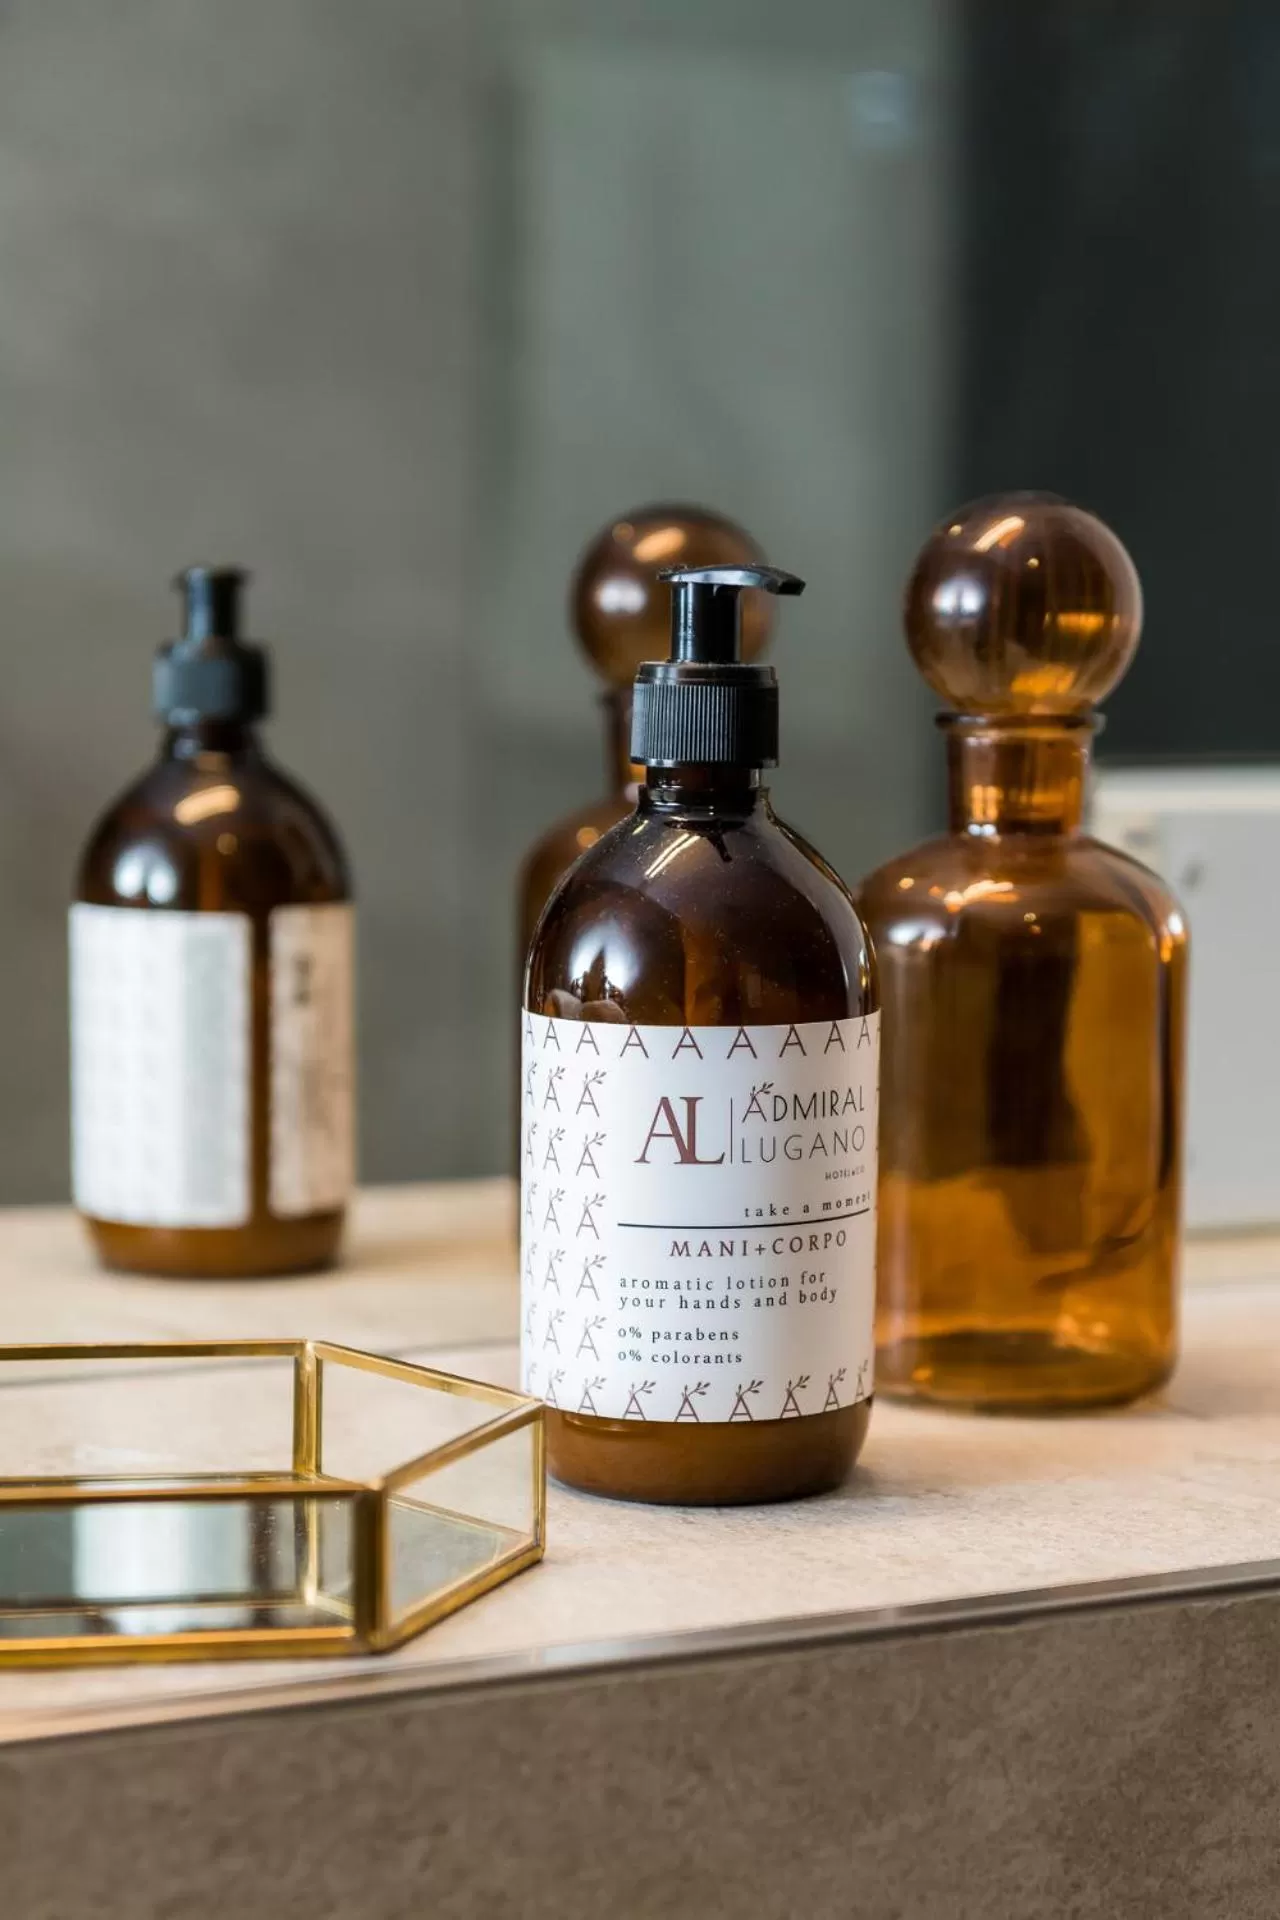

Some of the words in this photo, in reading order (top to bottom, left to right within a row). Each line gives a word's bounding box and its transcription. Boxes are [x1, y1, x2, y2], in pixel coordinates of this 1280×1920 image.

[543, 1018, 561, 1052] A
[576, 1022, 600, 1056] A
[620, 1025, 649, 1059] A
[672, 1026, 703, 1060] A
[726, 1025, 757, 1060] A
[778, 1023, 807, 1058] A
[824, 1020, 845, 1054] A
[633, 1096, 725, 1165] AL
[742, 1082, 865, 1123] ADMIRAL
[741, 1125, 865, 1163] LUGANO
[744, 1203, 790, 1218] take
[802, 1203, 810, 1214] a
[669, 1229, 847, 1258] MANI+CORPO
[619, 1276, 714, 1291] aromatic
[726, 1275, 790, 1290] lotion
[800, 1270, 826, 1285] for
[618, 1295, 667, 1310] your
[678, 1295, 742, 1310] hands
[753, 1291, 788, 1308] and
[799, 1286, 837, 1305] body
[617, 1326, 642, 1340] 0%
[651, 1327, 740, 1344] parabens
[617, 1349, 642, 1362] 0%
[651, 1350, 743, 1365] colorants
